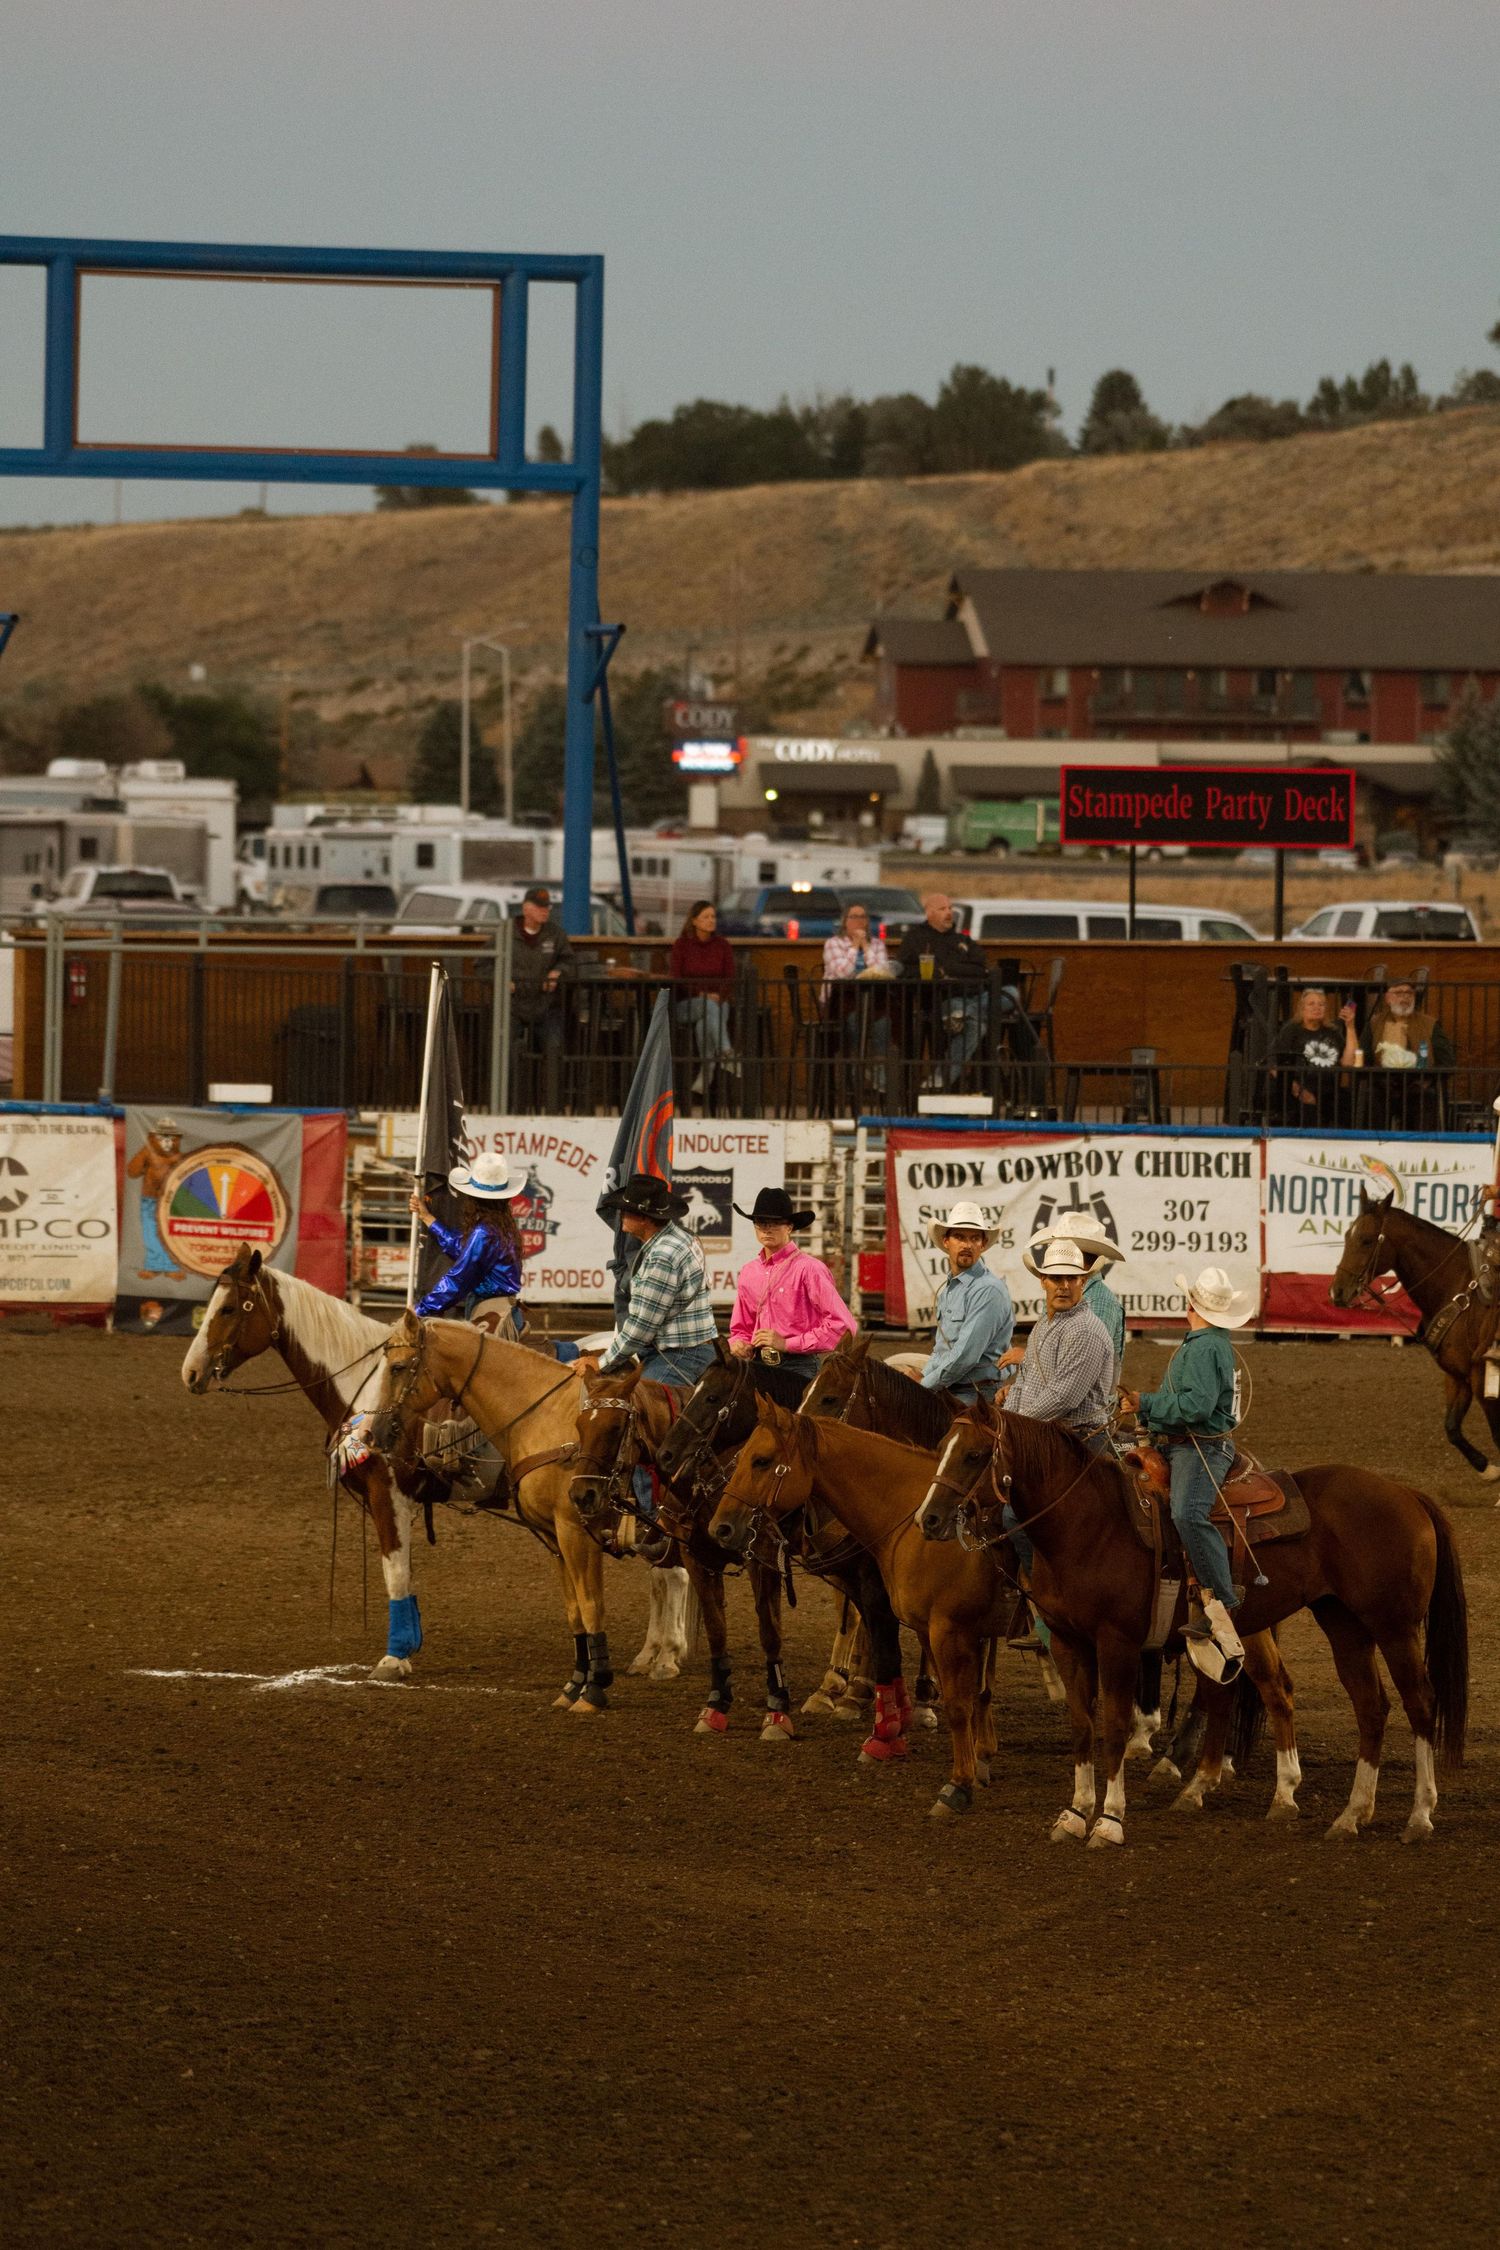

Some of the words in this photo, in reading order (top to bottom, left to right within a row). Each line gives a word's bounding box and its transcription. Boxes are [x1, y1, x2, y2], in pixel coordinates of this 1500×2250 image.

[774, 738, 839, 762] CODY
[1068, 784, 1193, 828] Stampede
[1205, 786, 1273, 830] Party
[1284, 786, 1345, 822] Deck
[493, 1131, 599, 1177] STAMPEDE
[678, 1134, 769, 1154] INDUCTEE
[907, 1160, 985, 1190] CODY
[1000, 1149, 1124, 1184] COWBOY
[1135, 1150, 1252, 1179] CHURCH
[1268, 1174, 1365, 1217] NORTH
[918, 1204, 1005, 1225] Suay
[1163, 1199, 1211, 1222] 307
[173, 1222, 218, 1235] PREVENT
[1131, 1230, 1249, 1254] 299-9193
[200, 1256, 233, 1265] DANGE
[541, 1269, 605, 1288] RODEO
